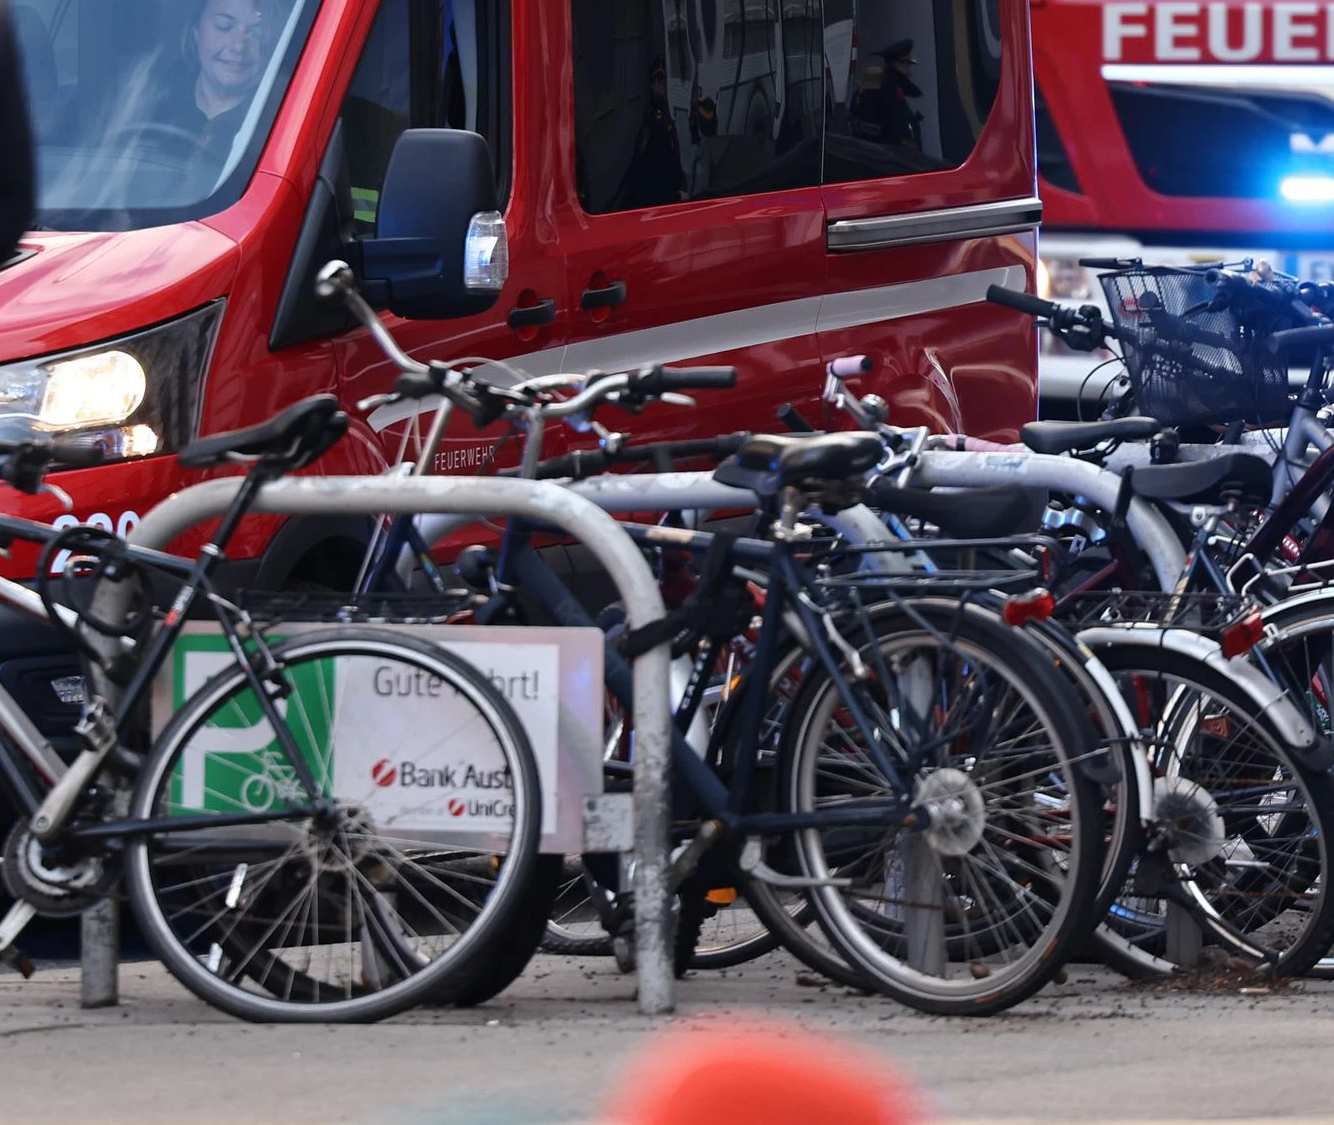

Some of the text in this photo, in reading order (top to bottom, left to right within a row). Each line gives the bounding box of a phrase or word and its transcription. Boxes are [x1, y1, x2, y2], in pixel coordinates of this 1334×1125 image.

[434, 445, 495, 471] FEUERWEHR
[374, 666, 443, 698] Gute
[400, 761, 514, 789] Bank Aust
[468, 799, 516, 817] UniCre
